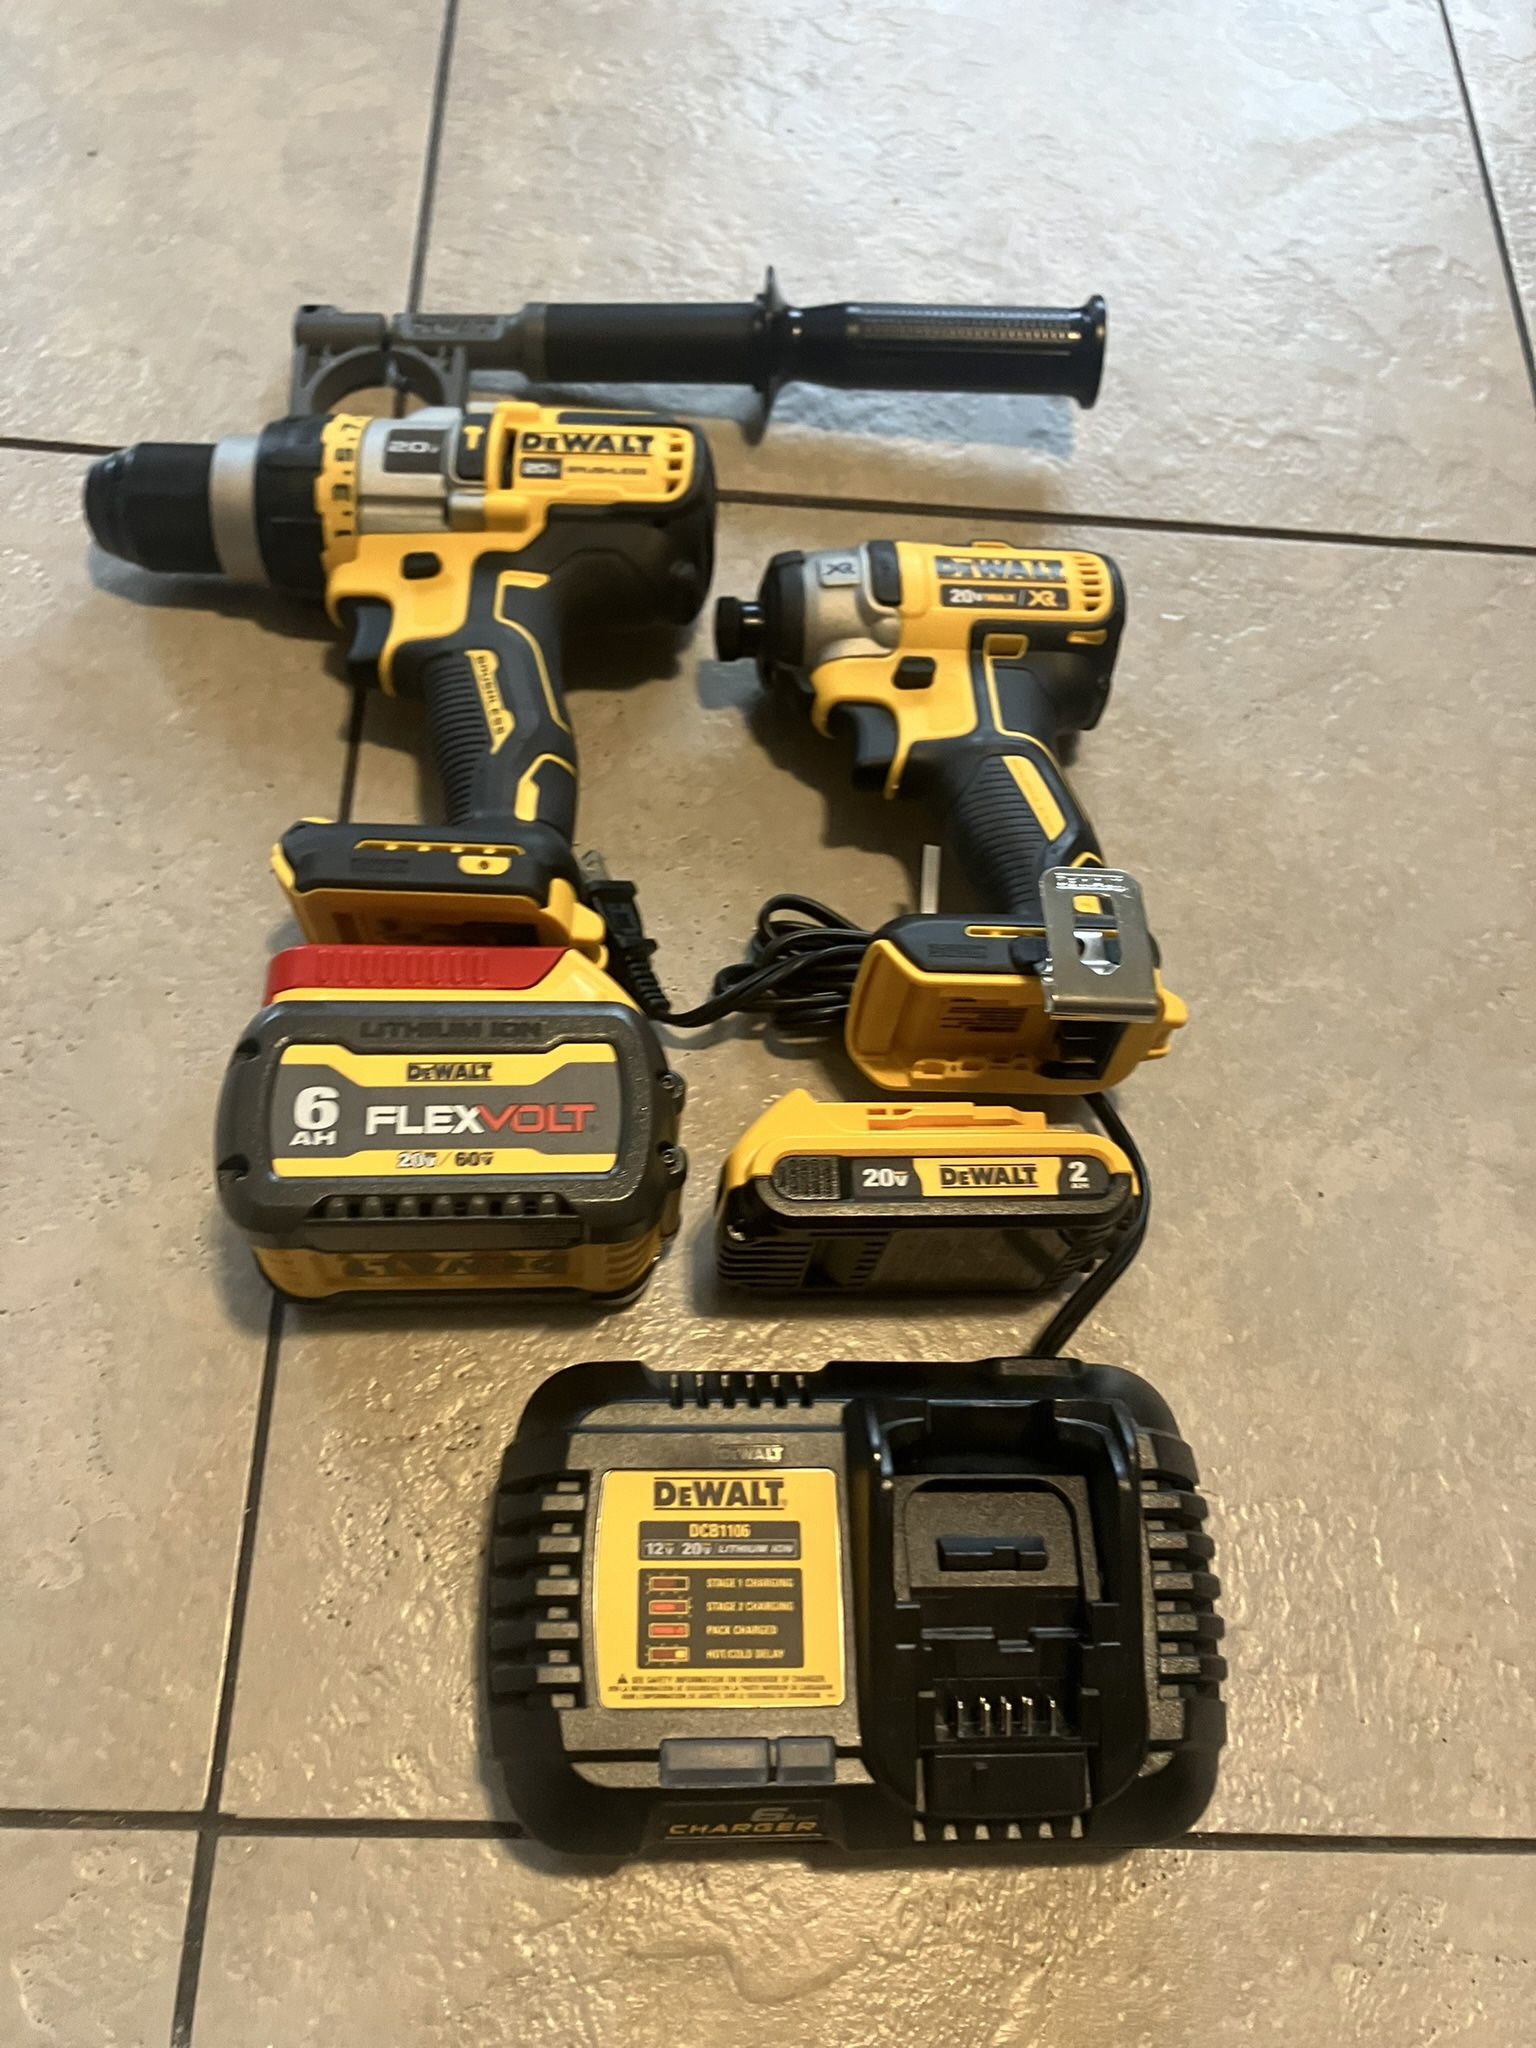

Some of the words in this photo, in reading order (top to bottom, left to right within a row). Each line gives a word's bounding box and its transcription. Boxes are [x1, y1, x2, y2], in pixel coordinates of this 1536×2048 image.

[522, 431, 655, 453] DeWALT
[1027, 590, 1059, 607] XR
[360, 1022, 481, 1039] LITHIUM
[490, 1021, 543, 1038] ION
[407, 1063, 493, 1081] DeWALT
[293, 1086, 341, 1131] 6
[365, 1104, 597, 1136] FLEXVOLT
[289, 1131, 338, 1146] AH
[862, 1167, 910, 1187] 20V
[940, 1167, 1038, 1186] DeWALT
[1067, 1161, 1089, 1183] 2
[653, 1480, 785, 1507] DeWALT
[689, 1523, 752, 1538] DCB1106
[669, 1821, 818, 1835] CHARGER
